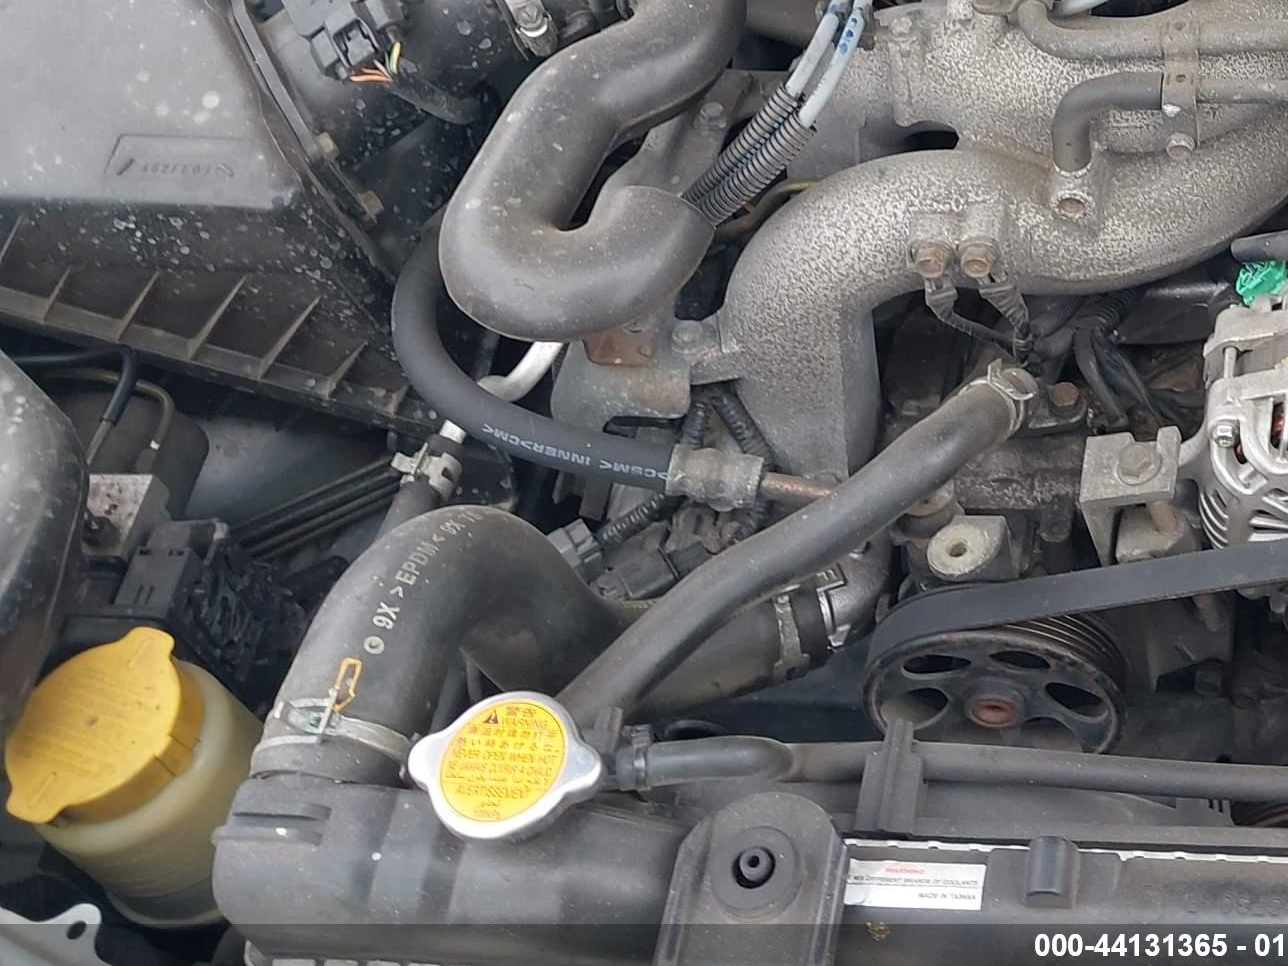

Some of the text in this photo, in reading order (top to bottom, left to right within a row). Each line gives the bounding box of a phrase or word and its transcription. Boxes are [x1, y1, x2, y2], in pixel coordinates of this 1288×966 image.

[373, 602, 400, 630] 9X
[483, 751, 505, 761] OPEN
[509, 753, 535, 764] WHEN
